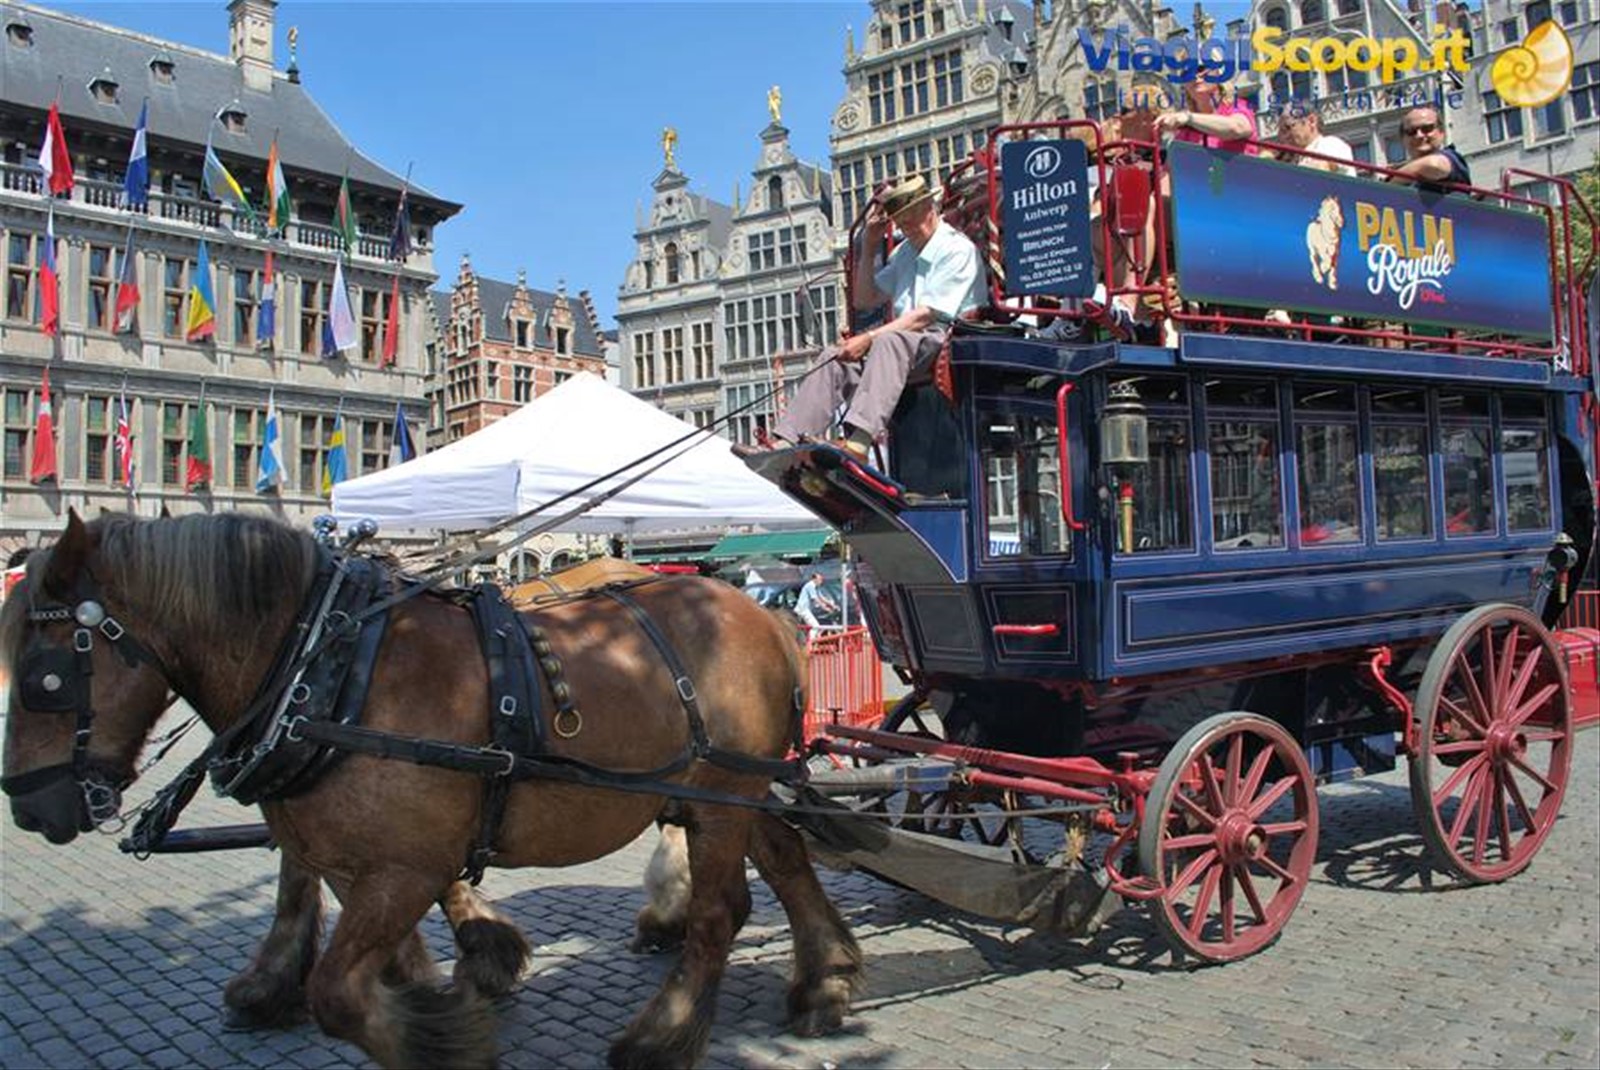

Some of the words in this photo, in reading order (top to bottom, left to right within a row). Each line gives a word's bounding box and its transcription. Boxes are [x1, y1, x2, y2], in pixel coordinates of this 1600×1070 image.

[1012, 179, 1077, 210] Hilton
[1023, 202, 1069, 222] Antwerp
[1355, 201, 1456, 265] PALM
[1367, 238, 1451, 310] Royale
